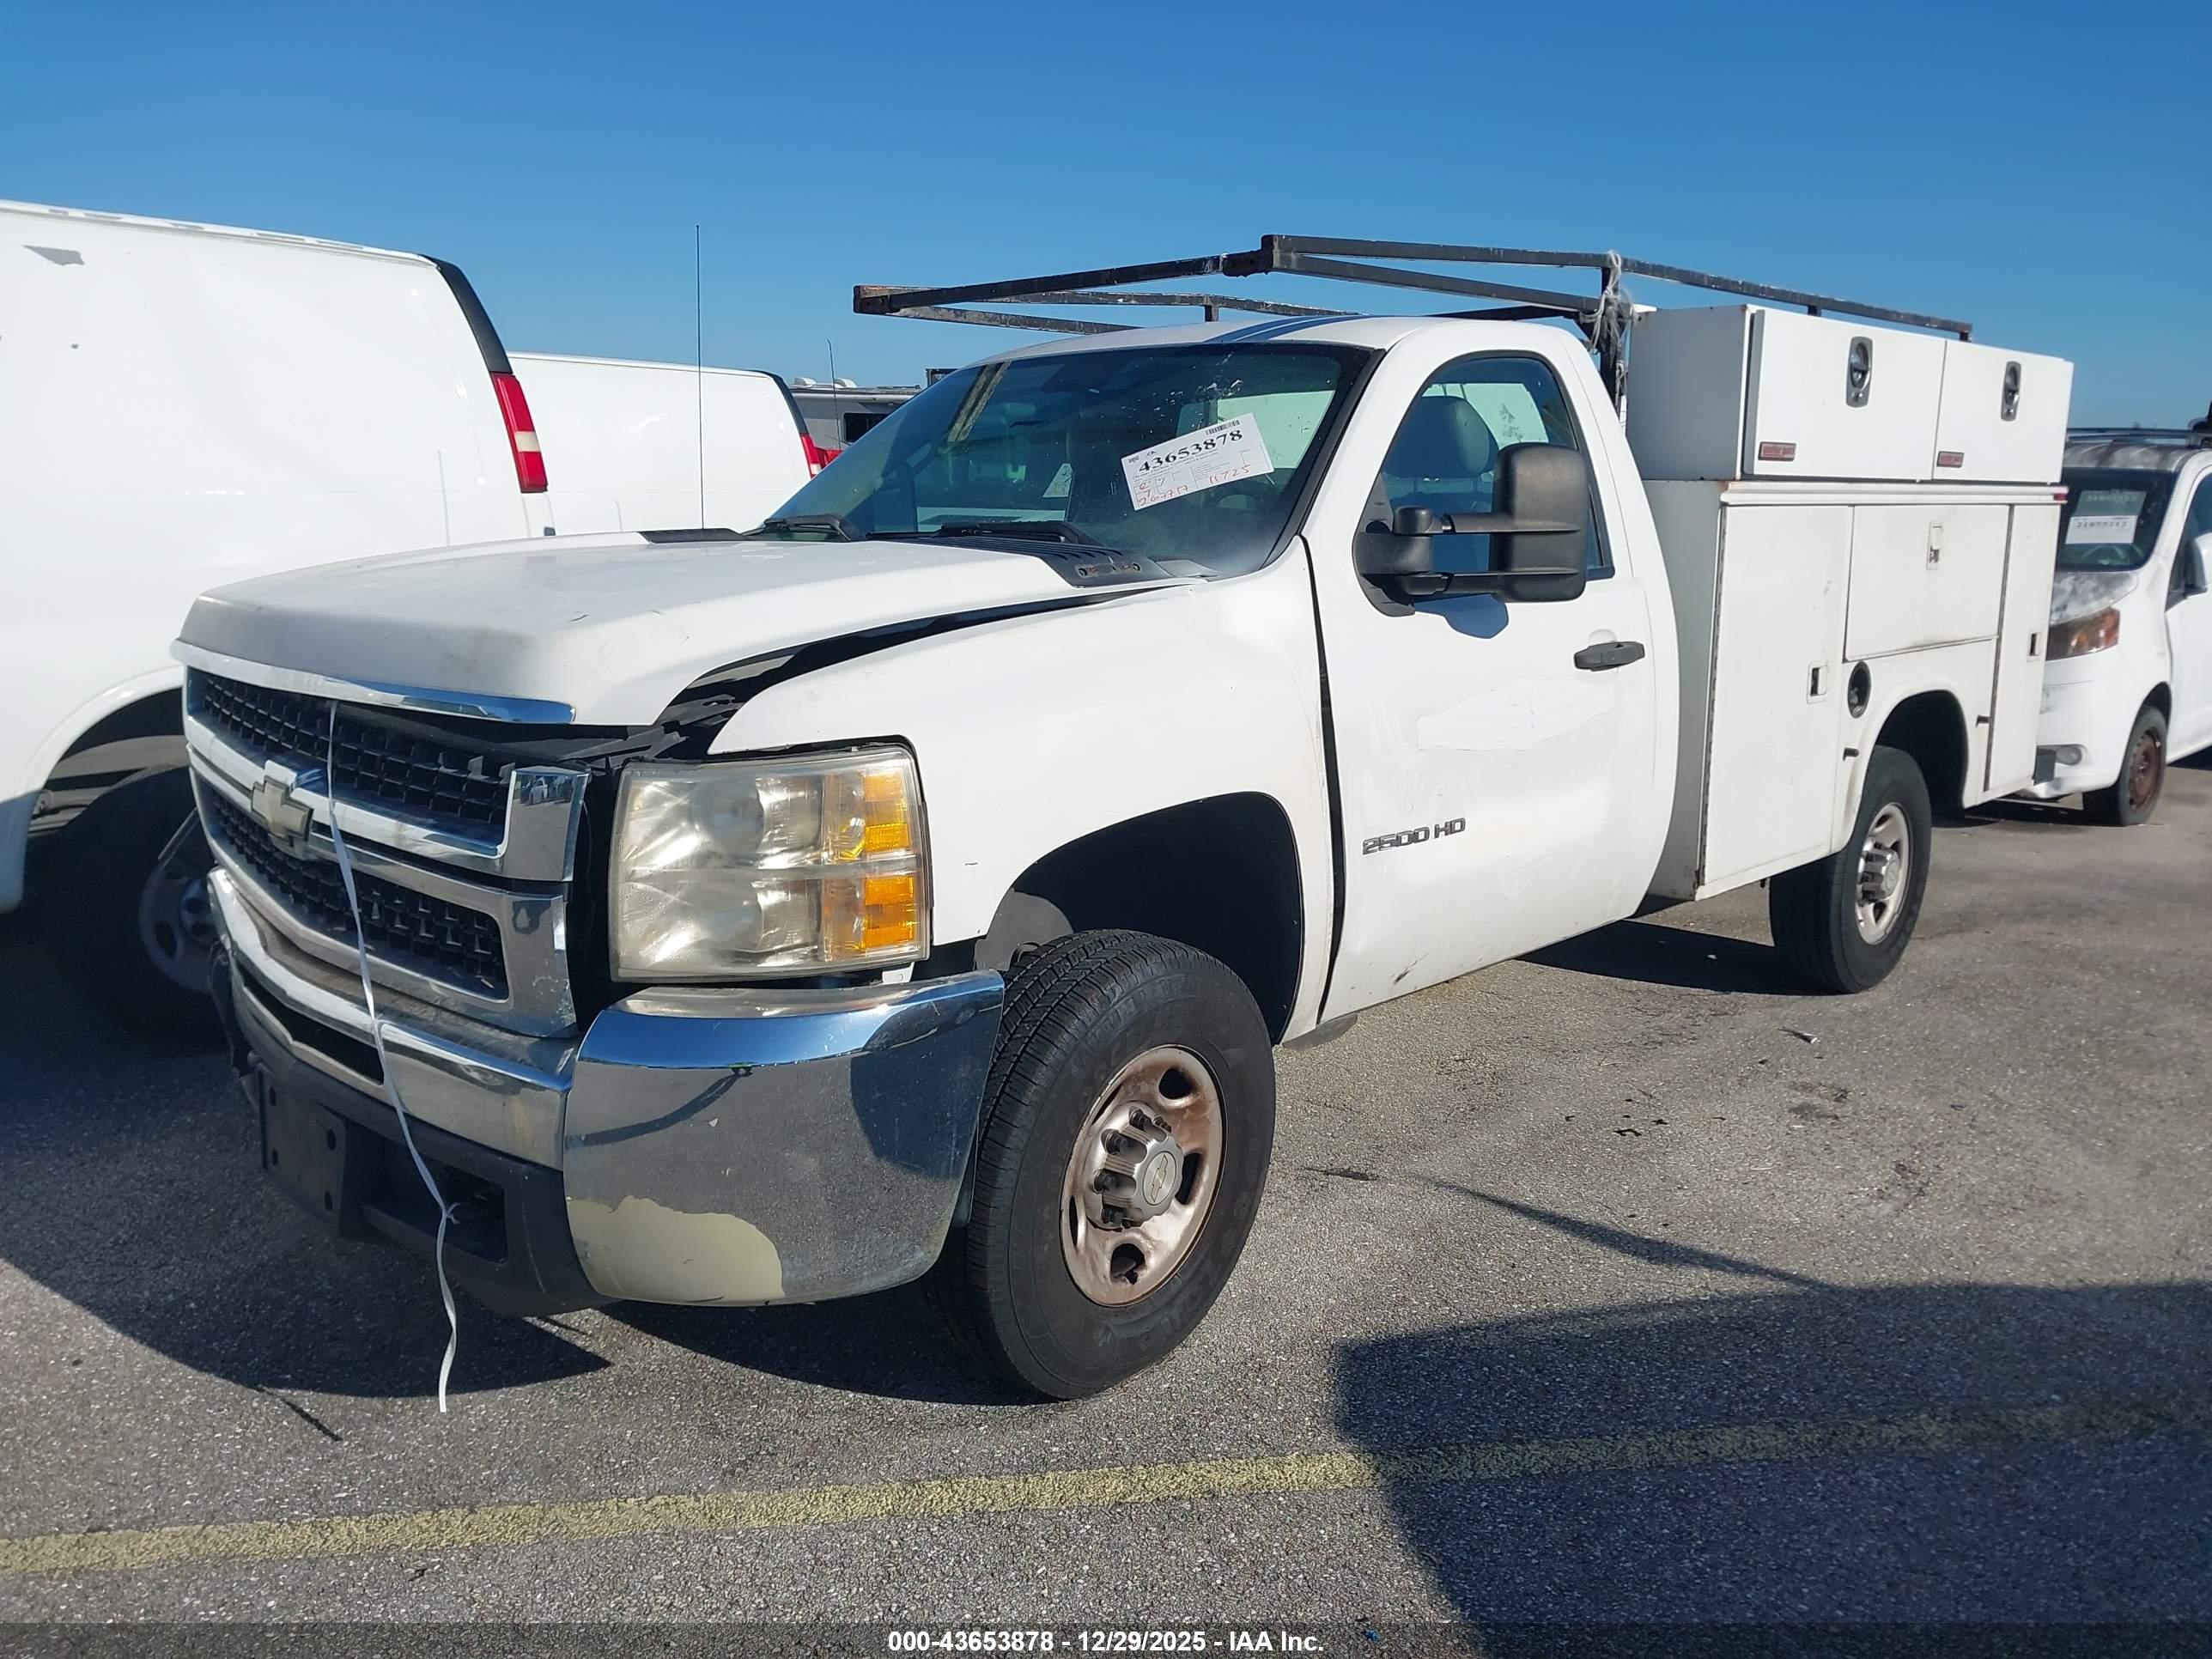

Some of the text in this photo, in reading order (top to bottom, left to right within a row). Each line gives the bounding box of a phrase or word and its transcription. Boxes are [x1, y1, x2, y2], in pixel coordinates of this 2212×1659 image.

[1139, 429, 1243, 472] 43653878
[1362, 817, 1467, 855] 2500 HD
